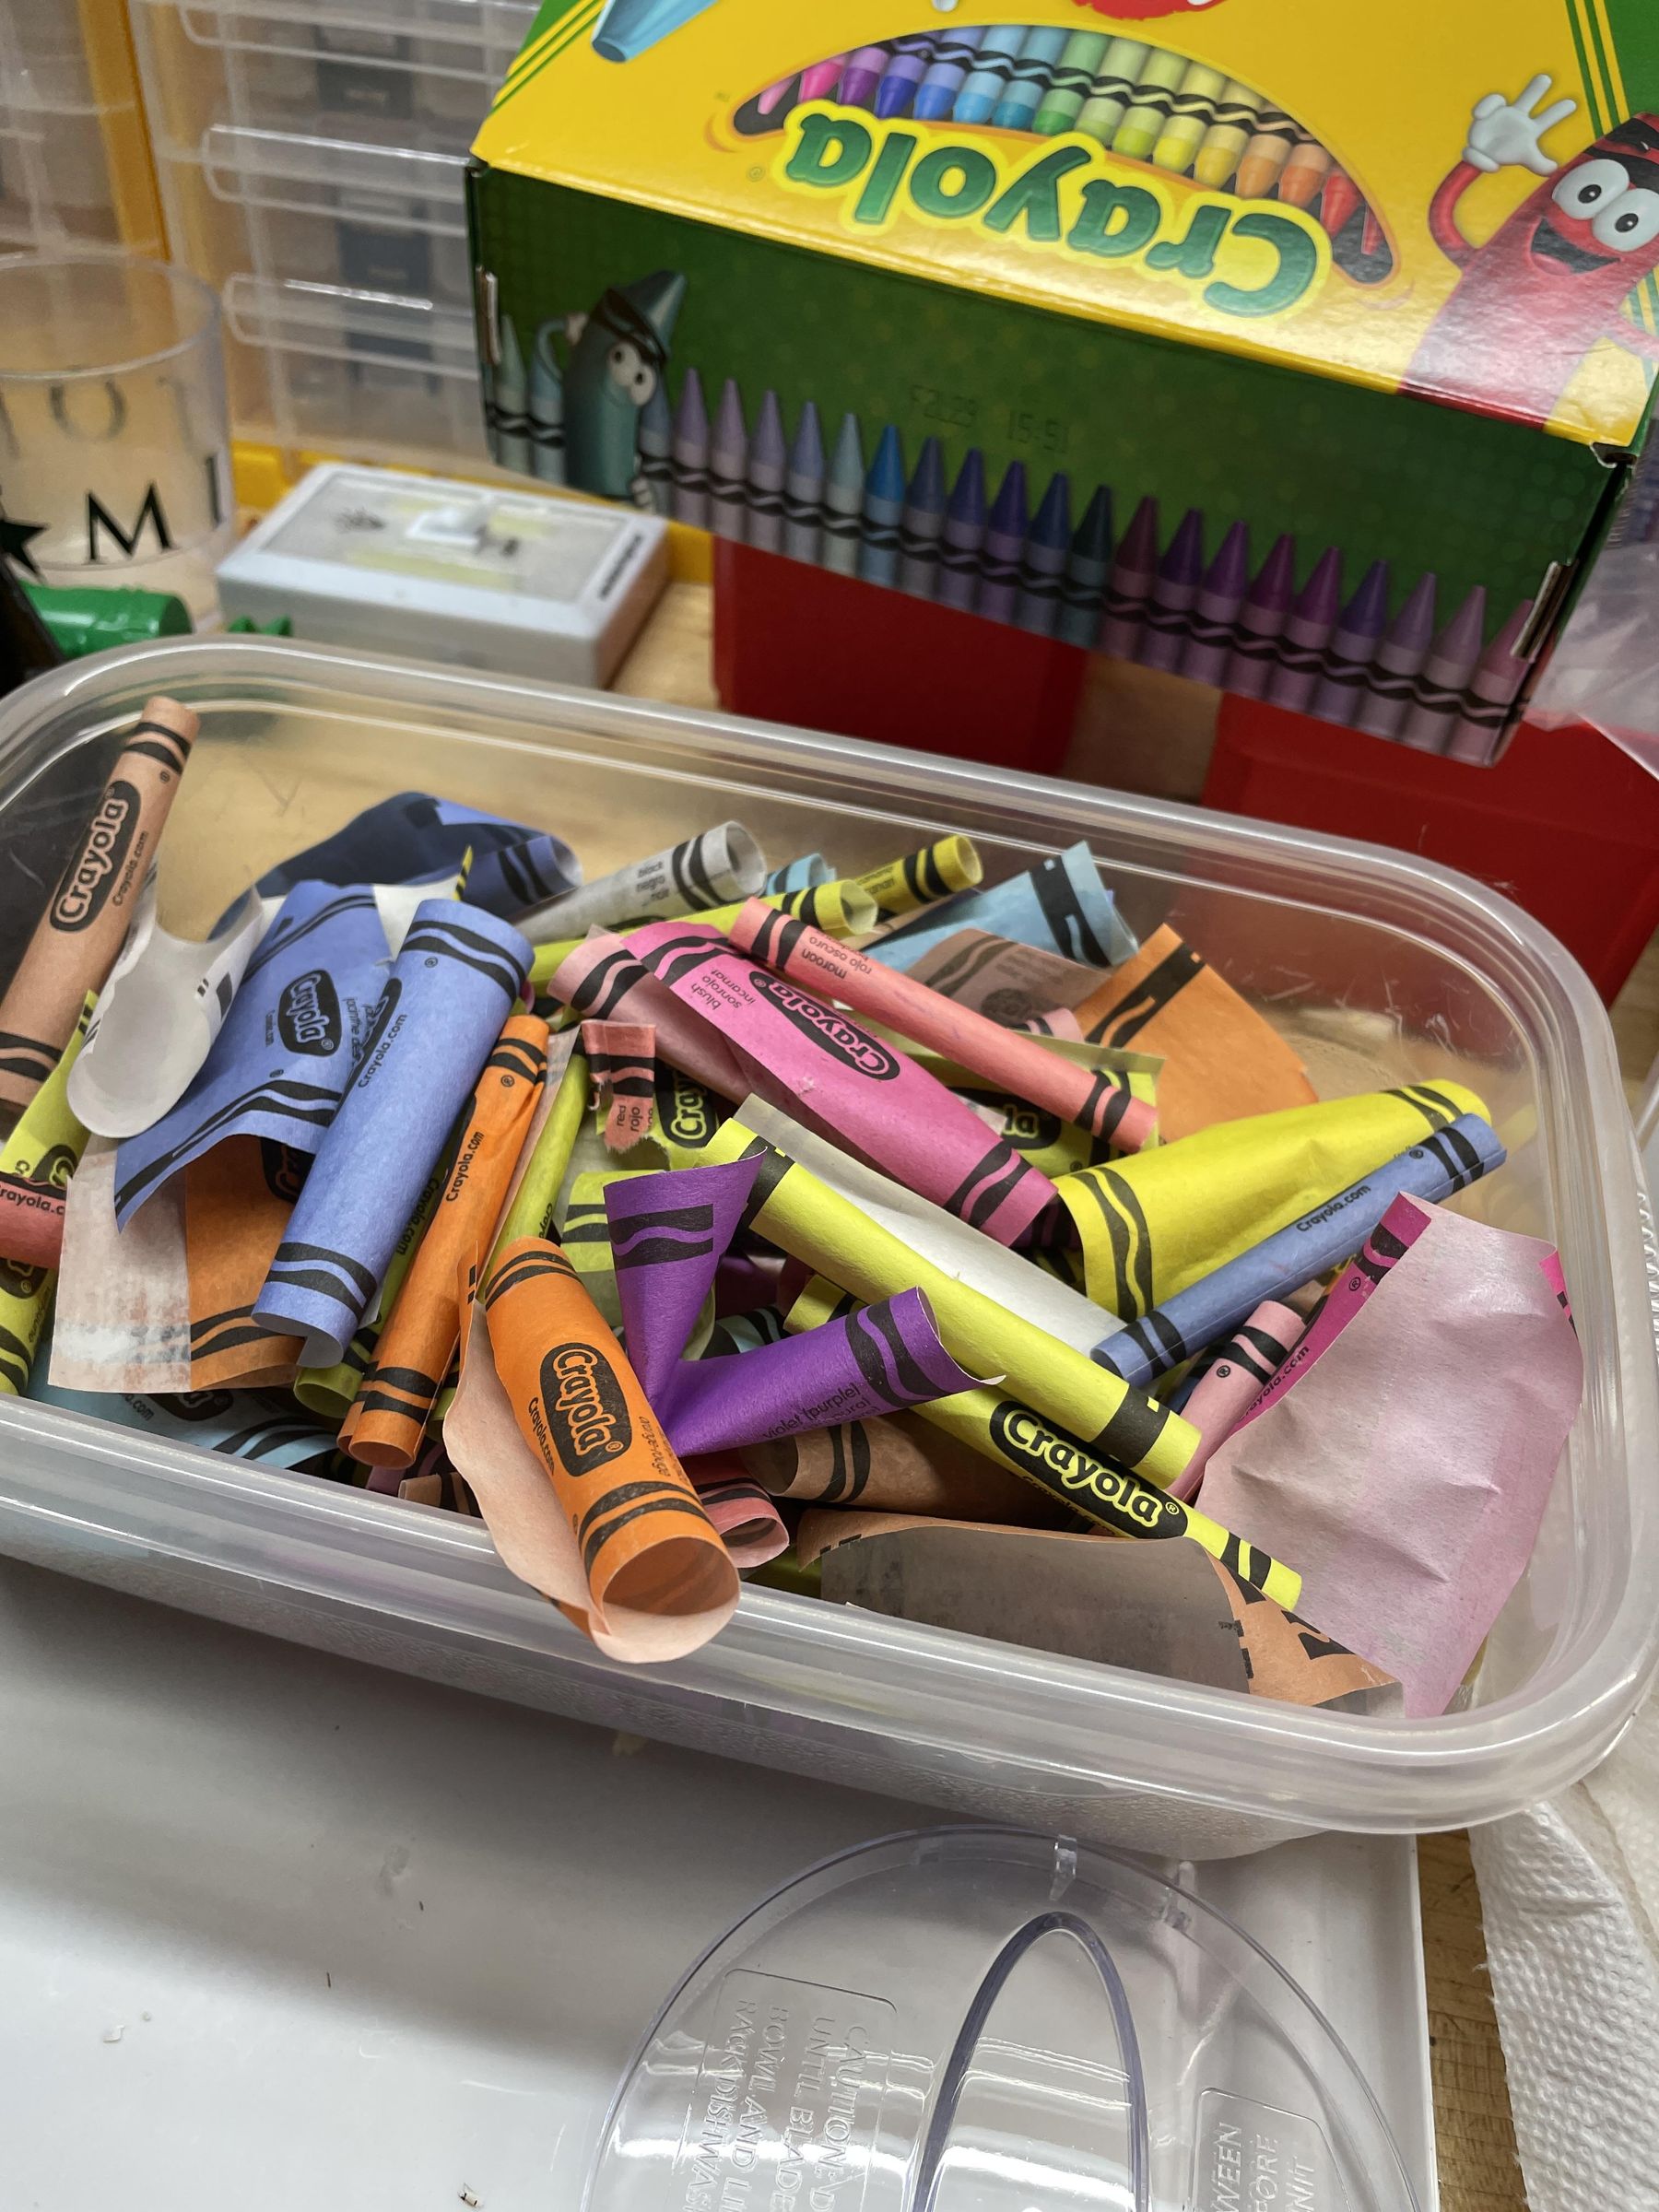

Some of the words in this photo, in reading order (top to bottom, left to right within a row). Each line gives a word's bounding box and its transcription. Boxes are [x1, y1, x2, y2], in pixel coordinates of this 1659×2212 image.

[785, 111, 1319, 319] Crayola
[58, 800, 124, 918] Crayola
[112, 830, 148, 906] Crayola.com
[801, 947, 849, 980] maroon
[807, 935, 849, 963] oscuro
[286, 973, 331, 1044] Crayola
[691, 982, 723, 1010] blush
[701, 974, 744, 1009] sonrojo
[711, 969, 758, 1005] incarnat
[358, 1013, 407, 1088] Crayola.com
[767, 979, 888, 1075] Crayola
[617, 1105, 627, 1126] red
[630, 1106, 643, 1132] rojo
[0, 1186, 65, 1216] rayola.c
[445, 1131, 486, 1202] Crayola.com
[396, 1178, 441, 1256] Crayola.com
[1295, 1184, 1372, 1232] Crayola.com
[554, 1349, 615, 1454] Crayola
[1238, 1345, 1311, 1421] rayola.com
[763, 1414, 805, 1439] violet
[1006, 1411, 1161, 1525] Crayola
